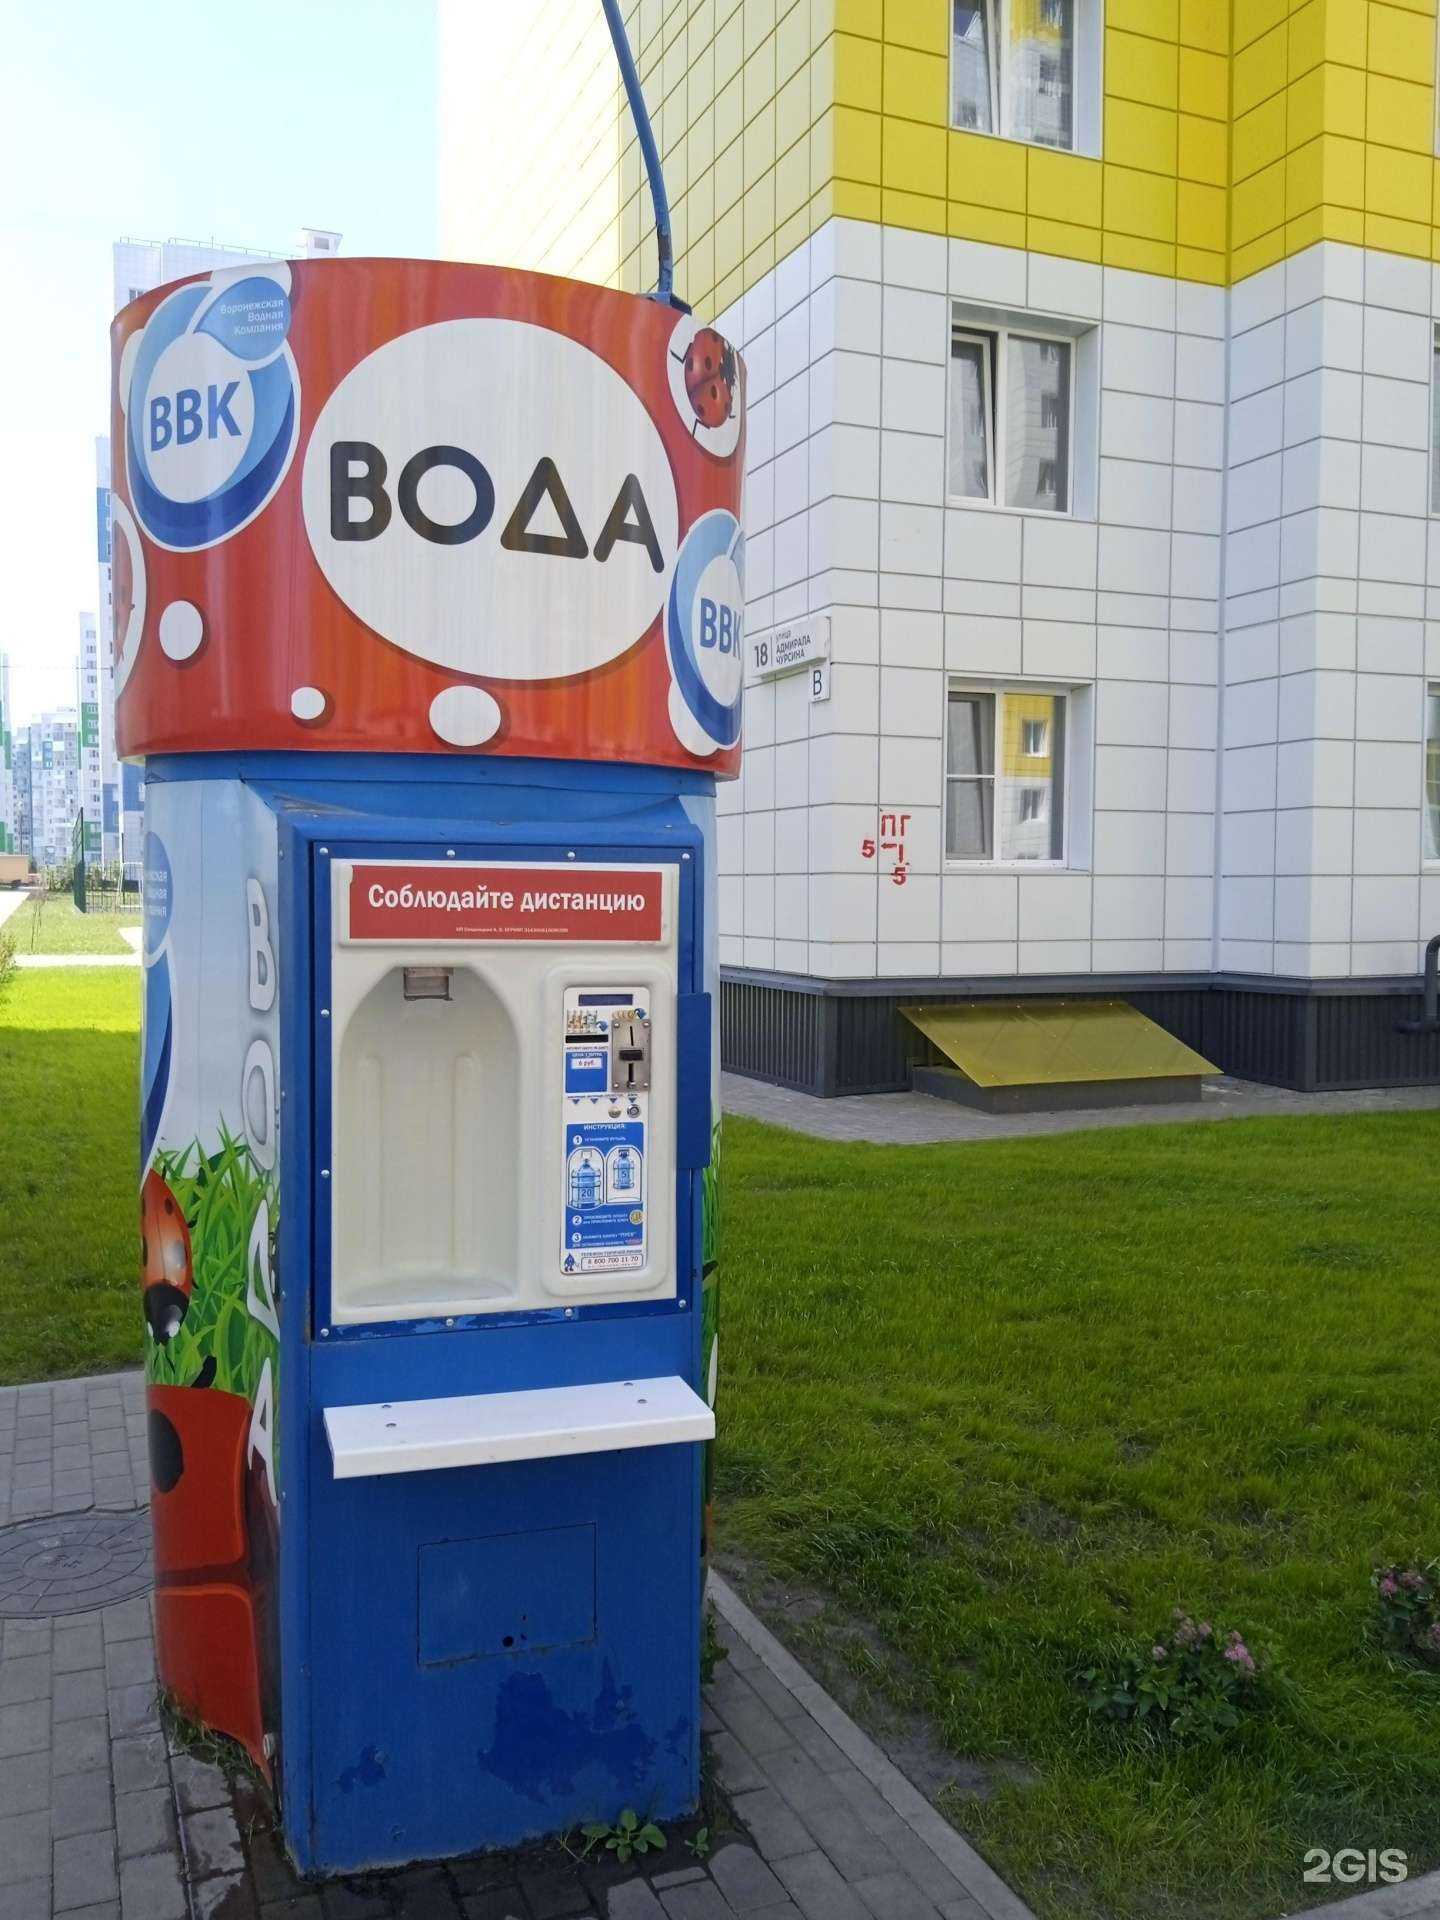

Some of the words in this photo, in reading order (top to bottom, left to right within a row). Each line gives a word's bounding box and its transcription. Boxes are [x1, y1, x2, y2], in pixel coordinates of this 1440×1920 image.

[220, 299, 284, 314] Воронежская
[248, 311, 284, 322] Водная
[233, 323, 284, 335] Компания
[149, 380, 242, 452] ВВК
[330, 441, 665, 574] ВОДА
[776, 634, 811, 654] АДМИРАЛА
[754, 643, 768, 668] 18
[776, 648, 805, 665] ЧУРСИНА
[881, 814, 911, 837] ПГ
[861, 840, 876, 859] 5
[892, 866, 907, 885] 5
[368, 884, 513, 912] Соблюдайте
[520, 889, 646, 913] дистанцию
